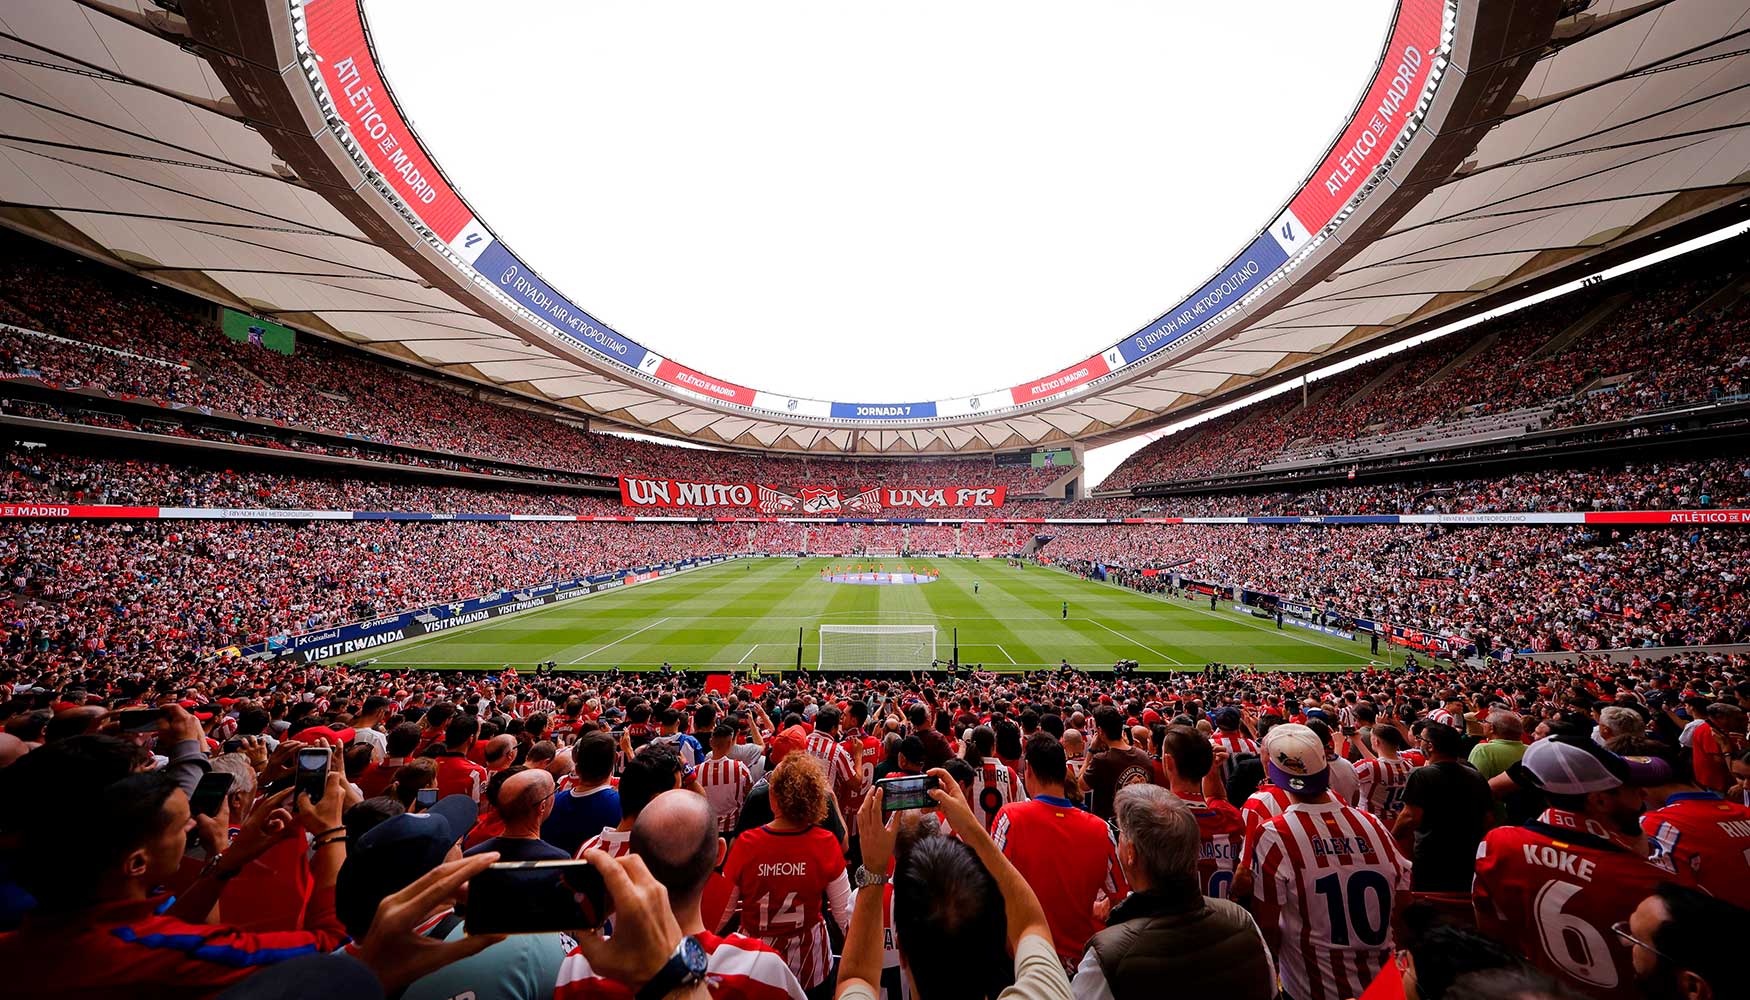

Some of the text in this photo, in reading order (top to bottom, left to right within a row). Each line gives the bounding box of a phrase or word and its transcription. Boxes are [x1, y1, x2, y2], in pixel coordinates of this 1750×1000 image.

[333, 56, 436, 204] ATLÉTICO DE MADRID
[1324, 45, 1422, 196] ATLÉTICO DE MADRID
[1146, 260, 1258, 346] RIYADH AIR METROPOLITANO
[513, 276, 628, 355] RIYADH AIR METROPOLITANO
[676, 372, 705, 390] ATLÉTICO
[710, 384, 736, 397] MADRID
[1031, 380, 1060, 395] ATLÉTICO
[1064, 368, 1088, 383] MADRID
[857, 406, 911, 416] JORNADA 7
[624, 478, 752, 506] UN MITO
[887, 488, 996, 508] UNA FE
[18, 507, 70, 516] MADRID
[1670, 512, 1726, 522] ATLÉTICO
[568, 587, 590, 599] RWANDA
[498, 603, 517, 615] VISIT
[516, 598, 544, 611] RWANDA
[1282, 603, 1304, 616] LALIGA
[424, 610, 490, 633] VISIT RWANDA
[304, 630, 404, 662] VISIT RWANDA
[308, 631, 336, 644] CaixaBank
[862, 746, 876, 756] AREZ
[976, 768, 1010, 784] TORRE
[1200, 842, 1238, 859] RASCO
[1313, 836, 1375, 856] ÁLEX B.
[758, 862, 806, 876] SIMEONE
[1523, 844, 1596, 882] KOKE
[756, 891, 804, 932] 14
[1315, 870, 1392, 946] 10
[1534, 879, 1618, 988] 6
